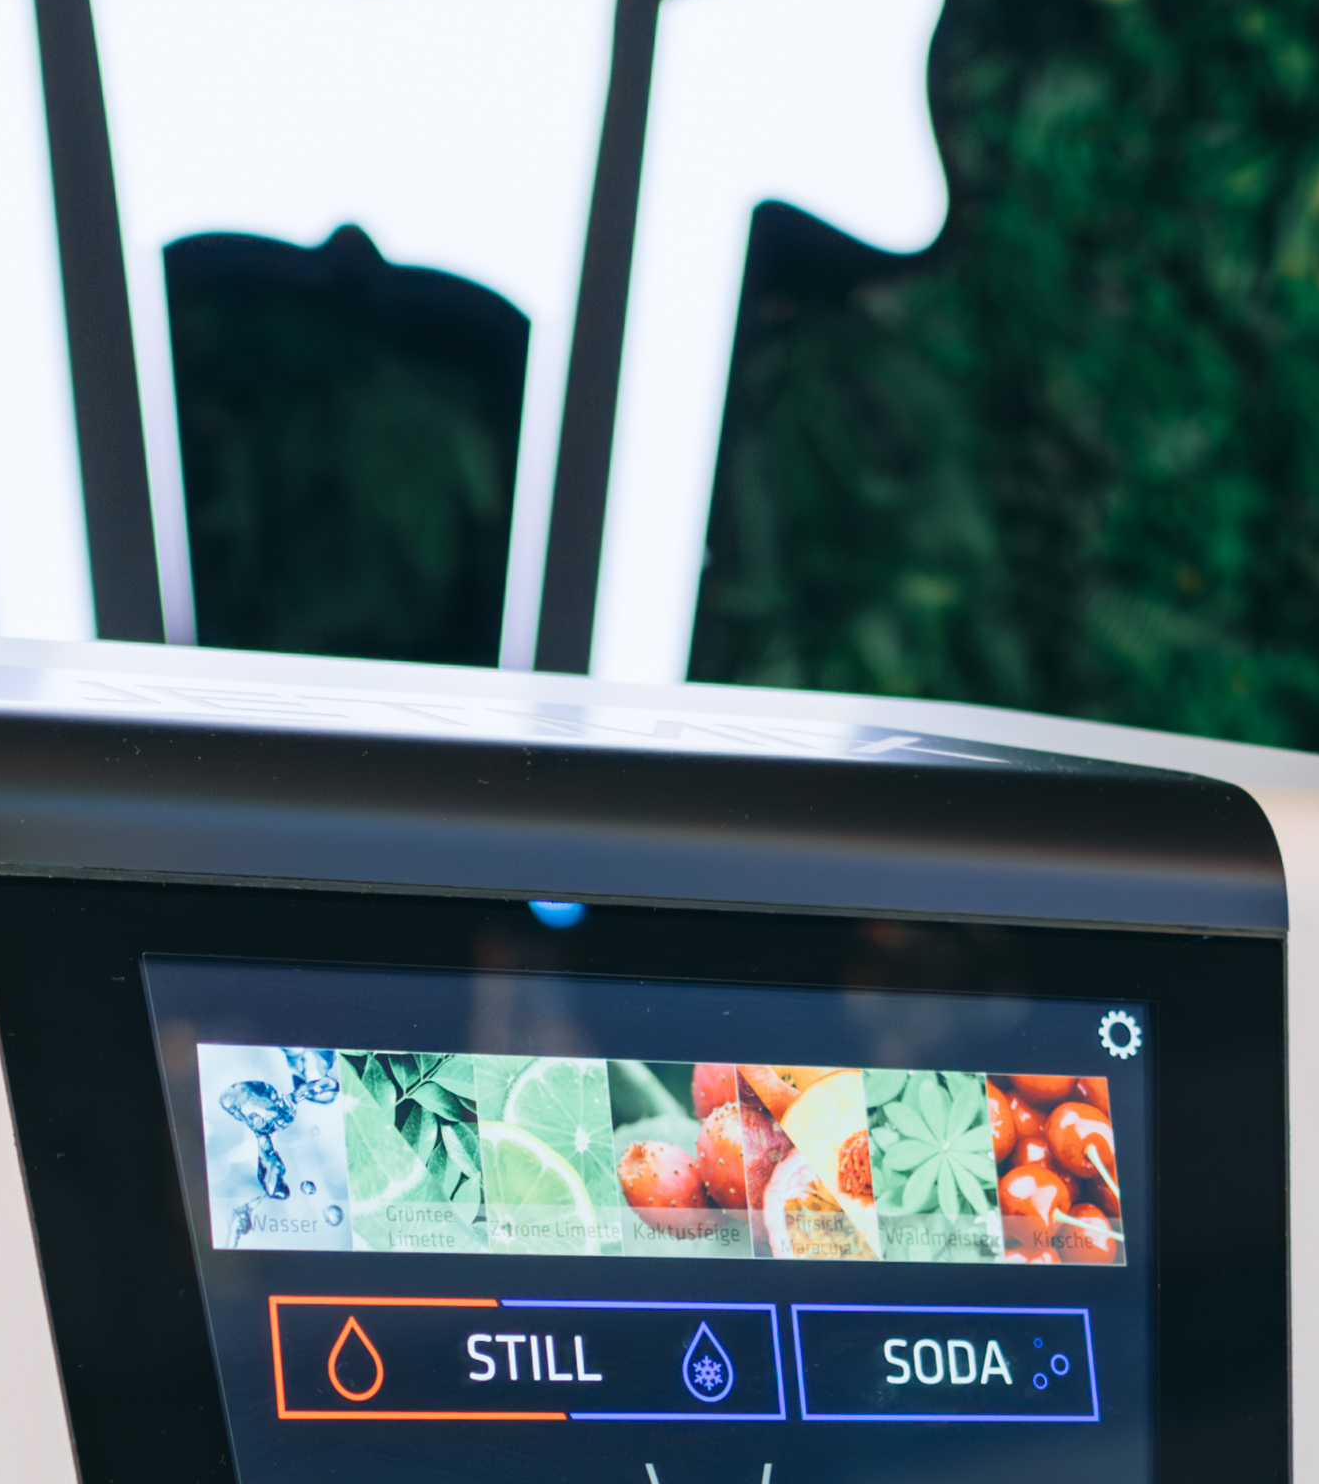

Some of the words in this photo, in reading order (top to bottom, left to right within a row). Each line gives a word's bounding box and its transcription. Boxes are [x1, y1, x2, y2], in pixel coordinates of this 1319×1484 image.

[248, 1214, 319, 1233] Wasser
[386, 1205, 454, 1223] Grüntee
[490, 1220, 550, 1237] Zitrone
[555, 1221, 621, 1239] Limette
[633, 1222, 741, 1247] Kaktusfeige
[388, 1231, 455, 1248] Limette
[1033, 1230, 1094, 1249] Kirsche
[466, 1332, 603, 1382] STILL
[883, 1337, 1014, 1386] SODA
